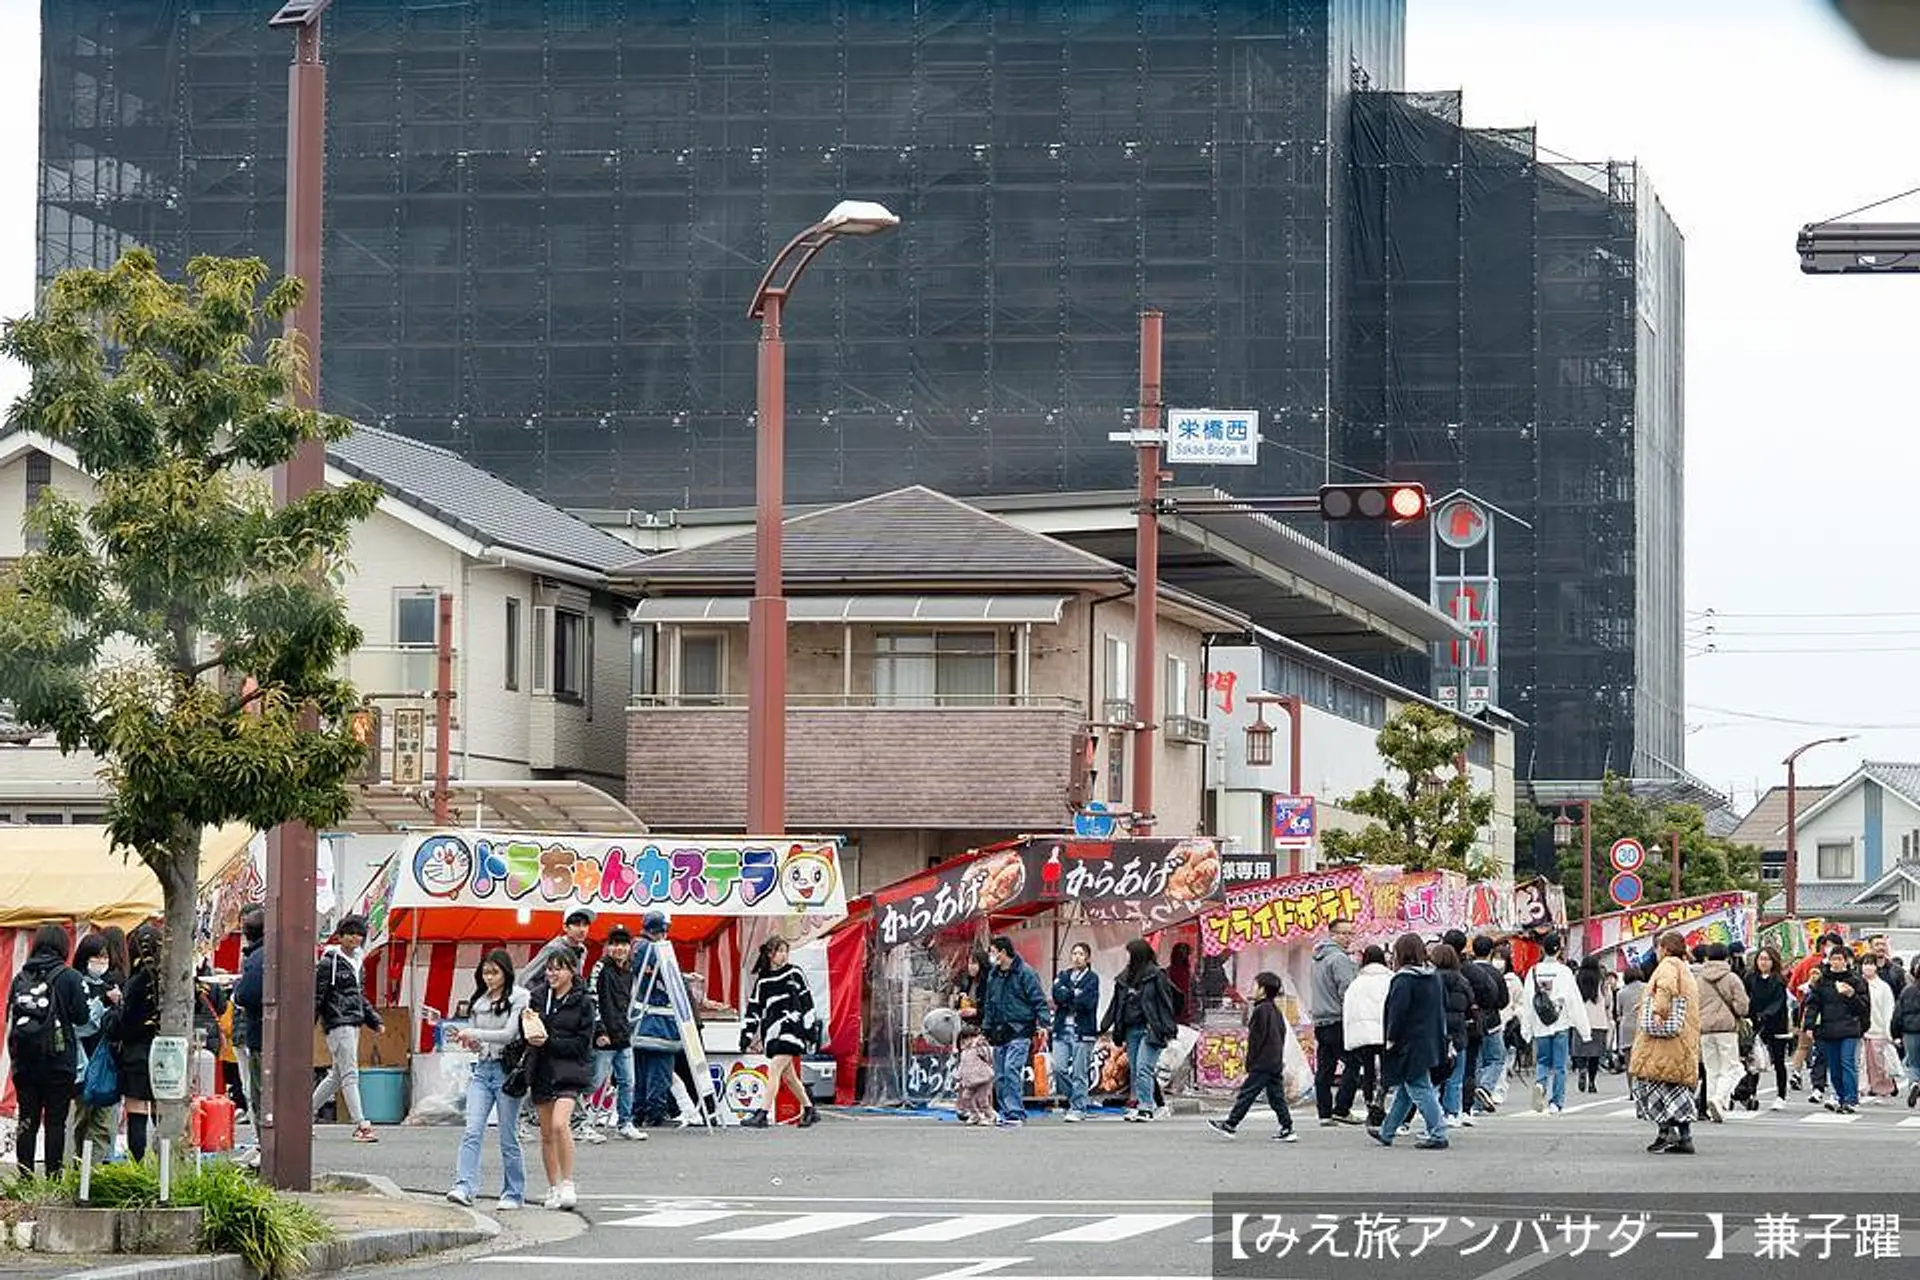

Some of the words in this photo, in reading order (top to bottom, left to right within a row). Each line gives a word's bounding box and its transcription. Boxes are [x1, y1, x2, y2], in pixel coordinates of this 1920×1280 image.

[1178, 418, 1248, 441] 栄橋西
[1175, 443, 1204, 455] Sakae
[1206, 442, 1236, 457] Bridge
[472, 839, 779, 906] ドラちゃんカステラ
[1618, 848, 1638, 863] 30
[1065, 855, 1184, 898] からあげ
[1226, 891, 1273, 906] FRIED
[1278, 879, 1336, 898] POTATO
[881, 871, 988, 944] からあげ
[1208, 886, 1362, 945] フライドポテト
